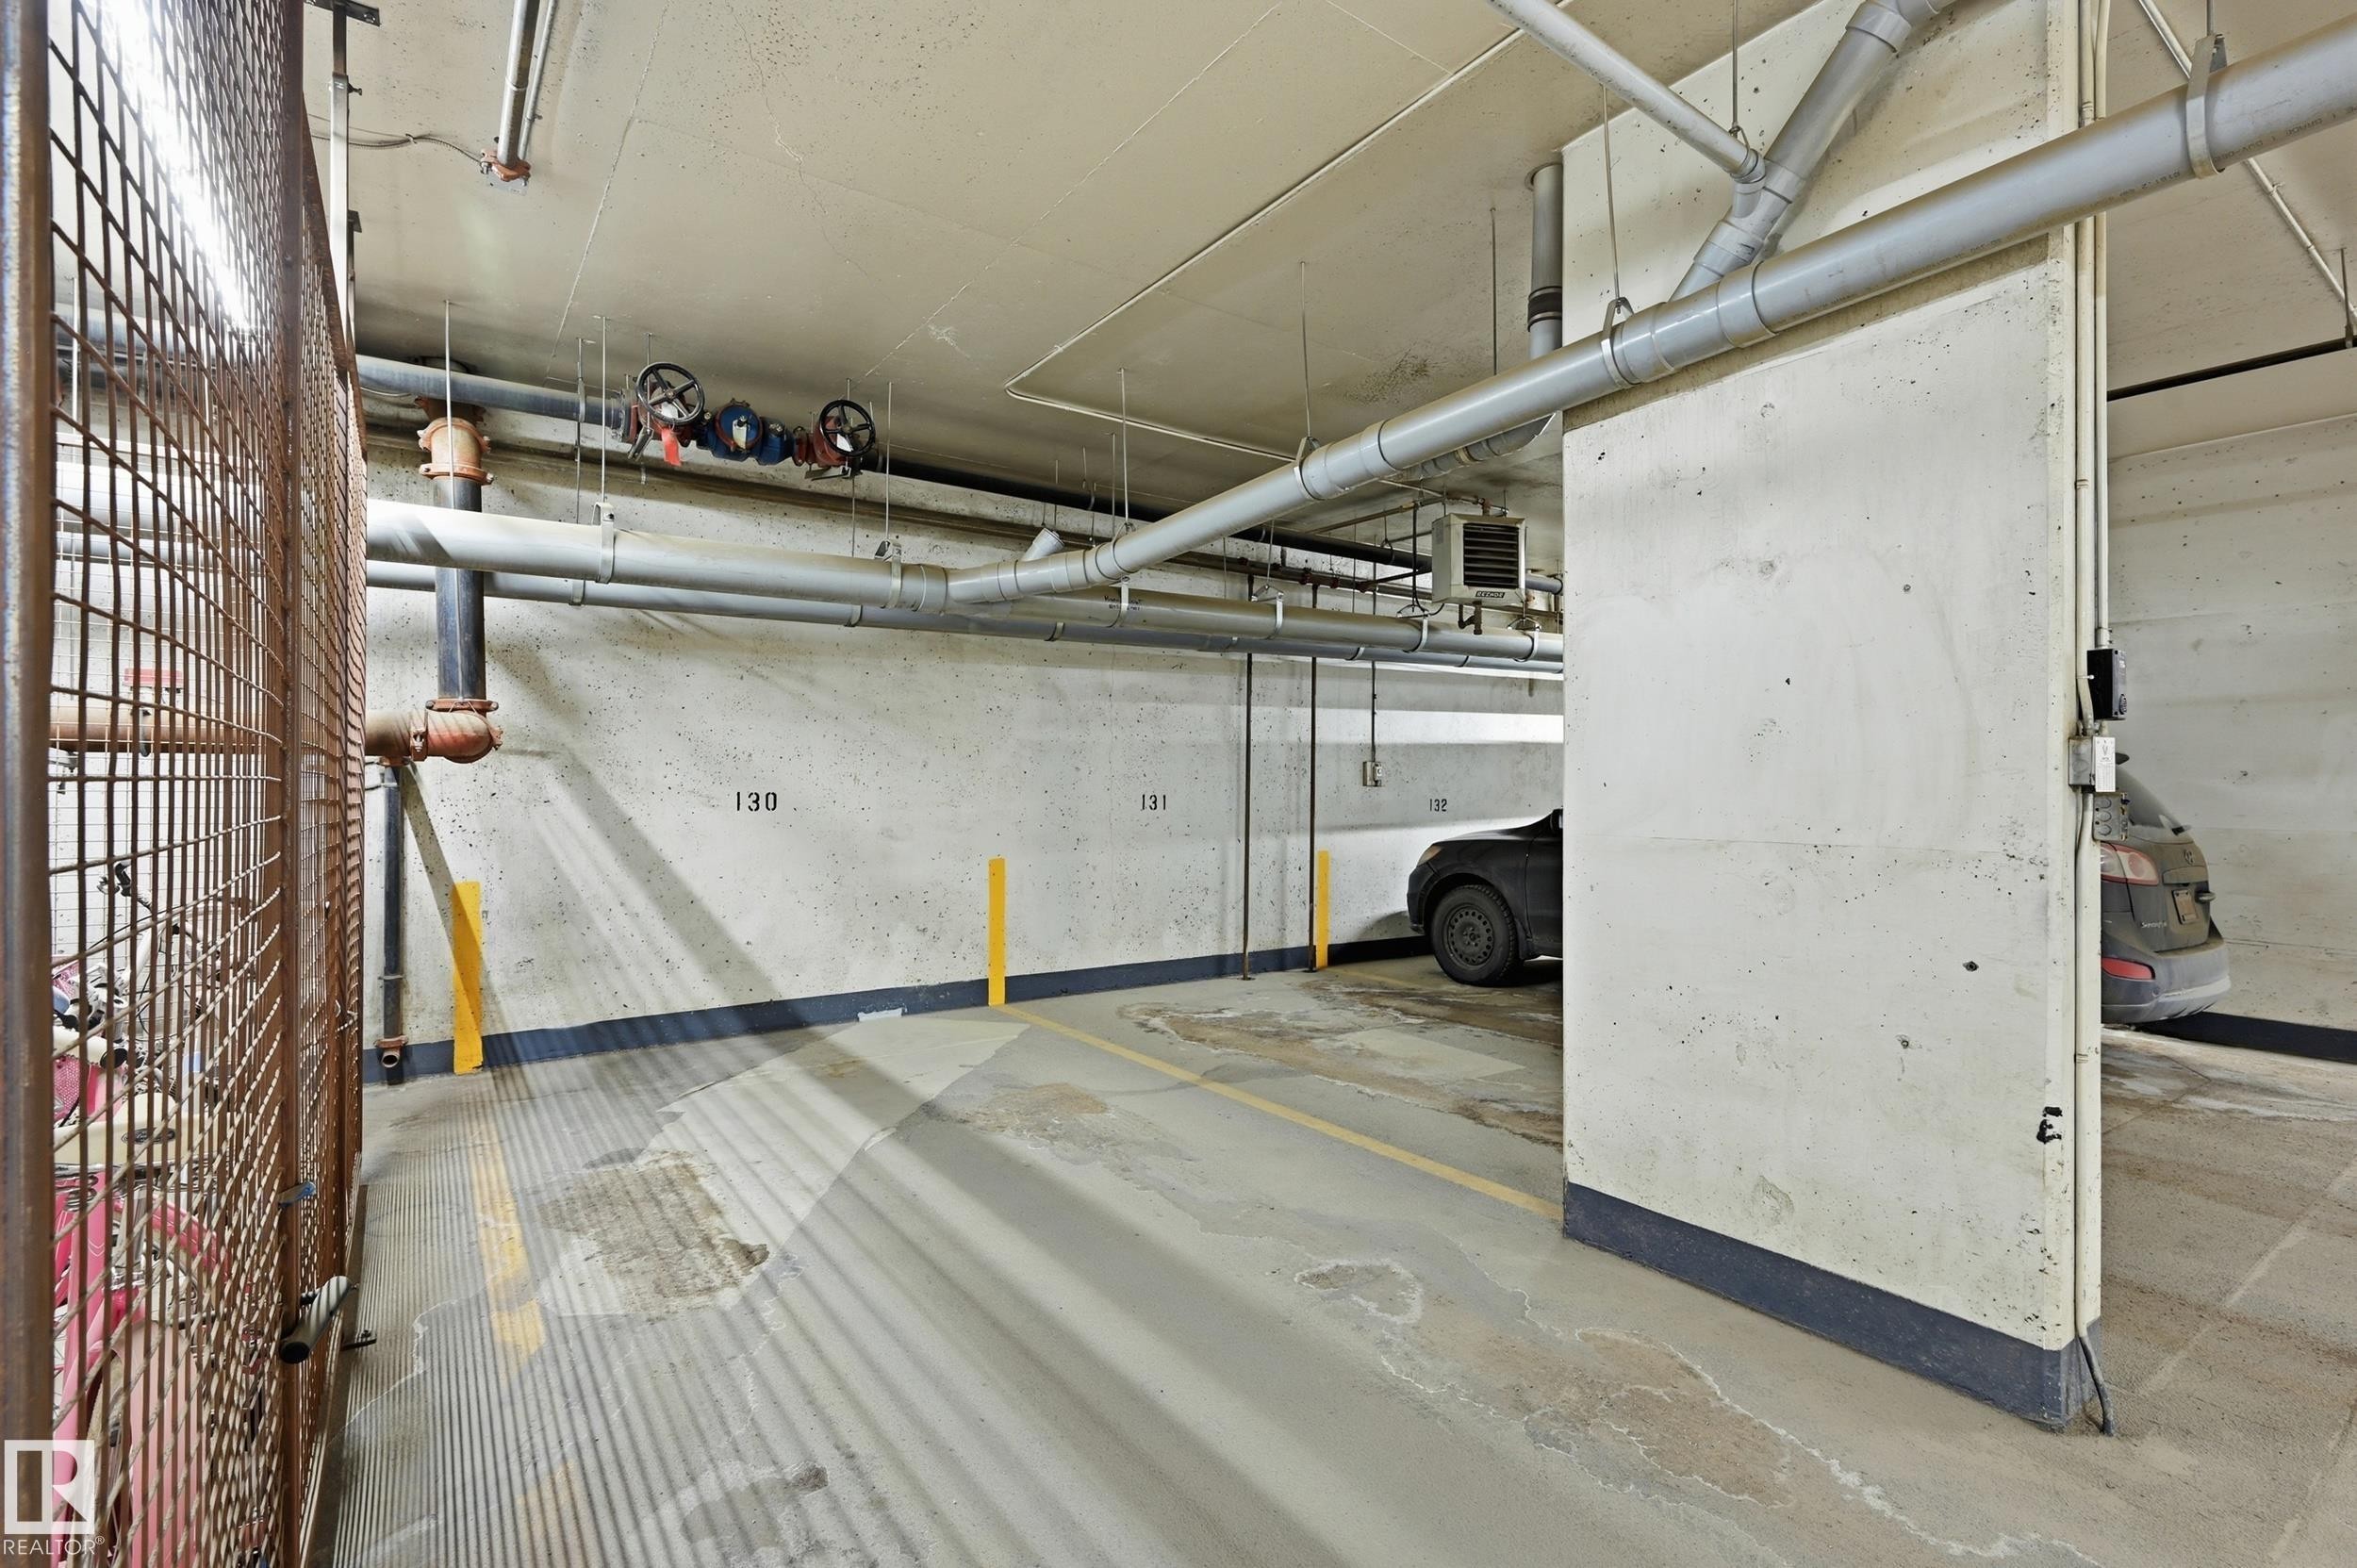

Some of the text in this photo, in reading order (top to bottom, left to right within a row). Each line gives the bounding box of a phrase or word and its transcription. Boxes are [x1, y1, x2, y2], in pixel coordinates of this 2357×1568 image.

[736, 791, 778, 812] 130
[1142, 794, 1166, 811] 131
[1429, 799, 1447, 812] 132
